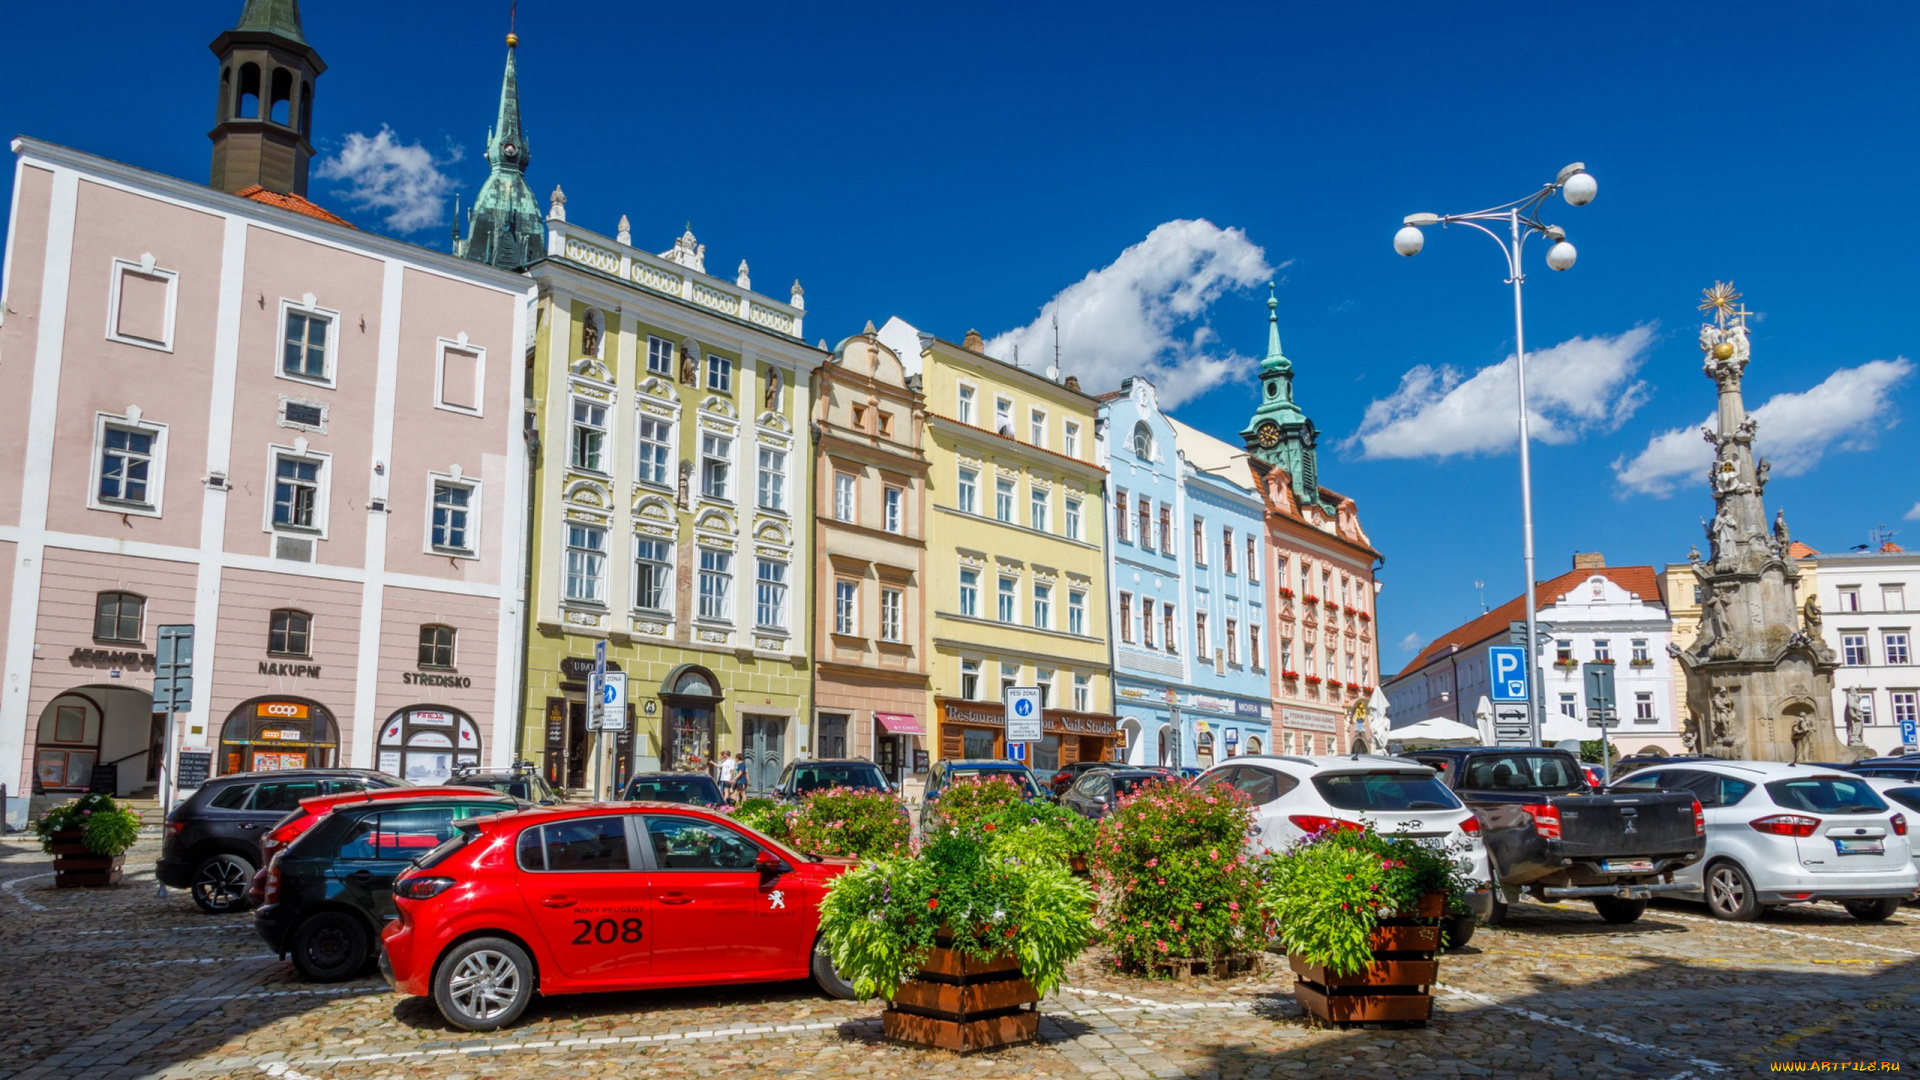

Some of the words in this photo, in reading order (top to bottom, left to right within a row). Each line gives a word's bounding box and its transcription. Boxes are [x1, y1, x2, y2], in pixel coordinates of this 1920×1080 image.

[1497, 653, 1518, 684] P
[267, 704, 298, 717] coop
[1238, 702, 1259, 713] MOIRA
[948, 705, 1005, 725] Restauran
[1061, 716, 1085, 732] Nails
[1085, 719, 1115, 735] Studio
[1903, 722, 1914, 737] P
[572, 918, 643, 945] 208
